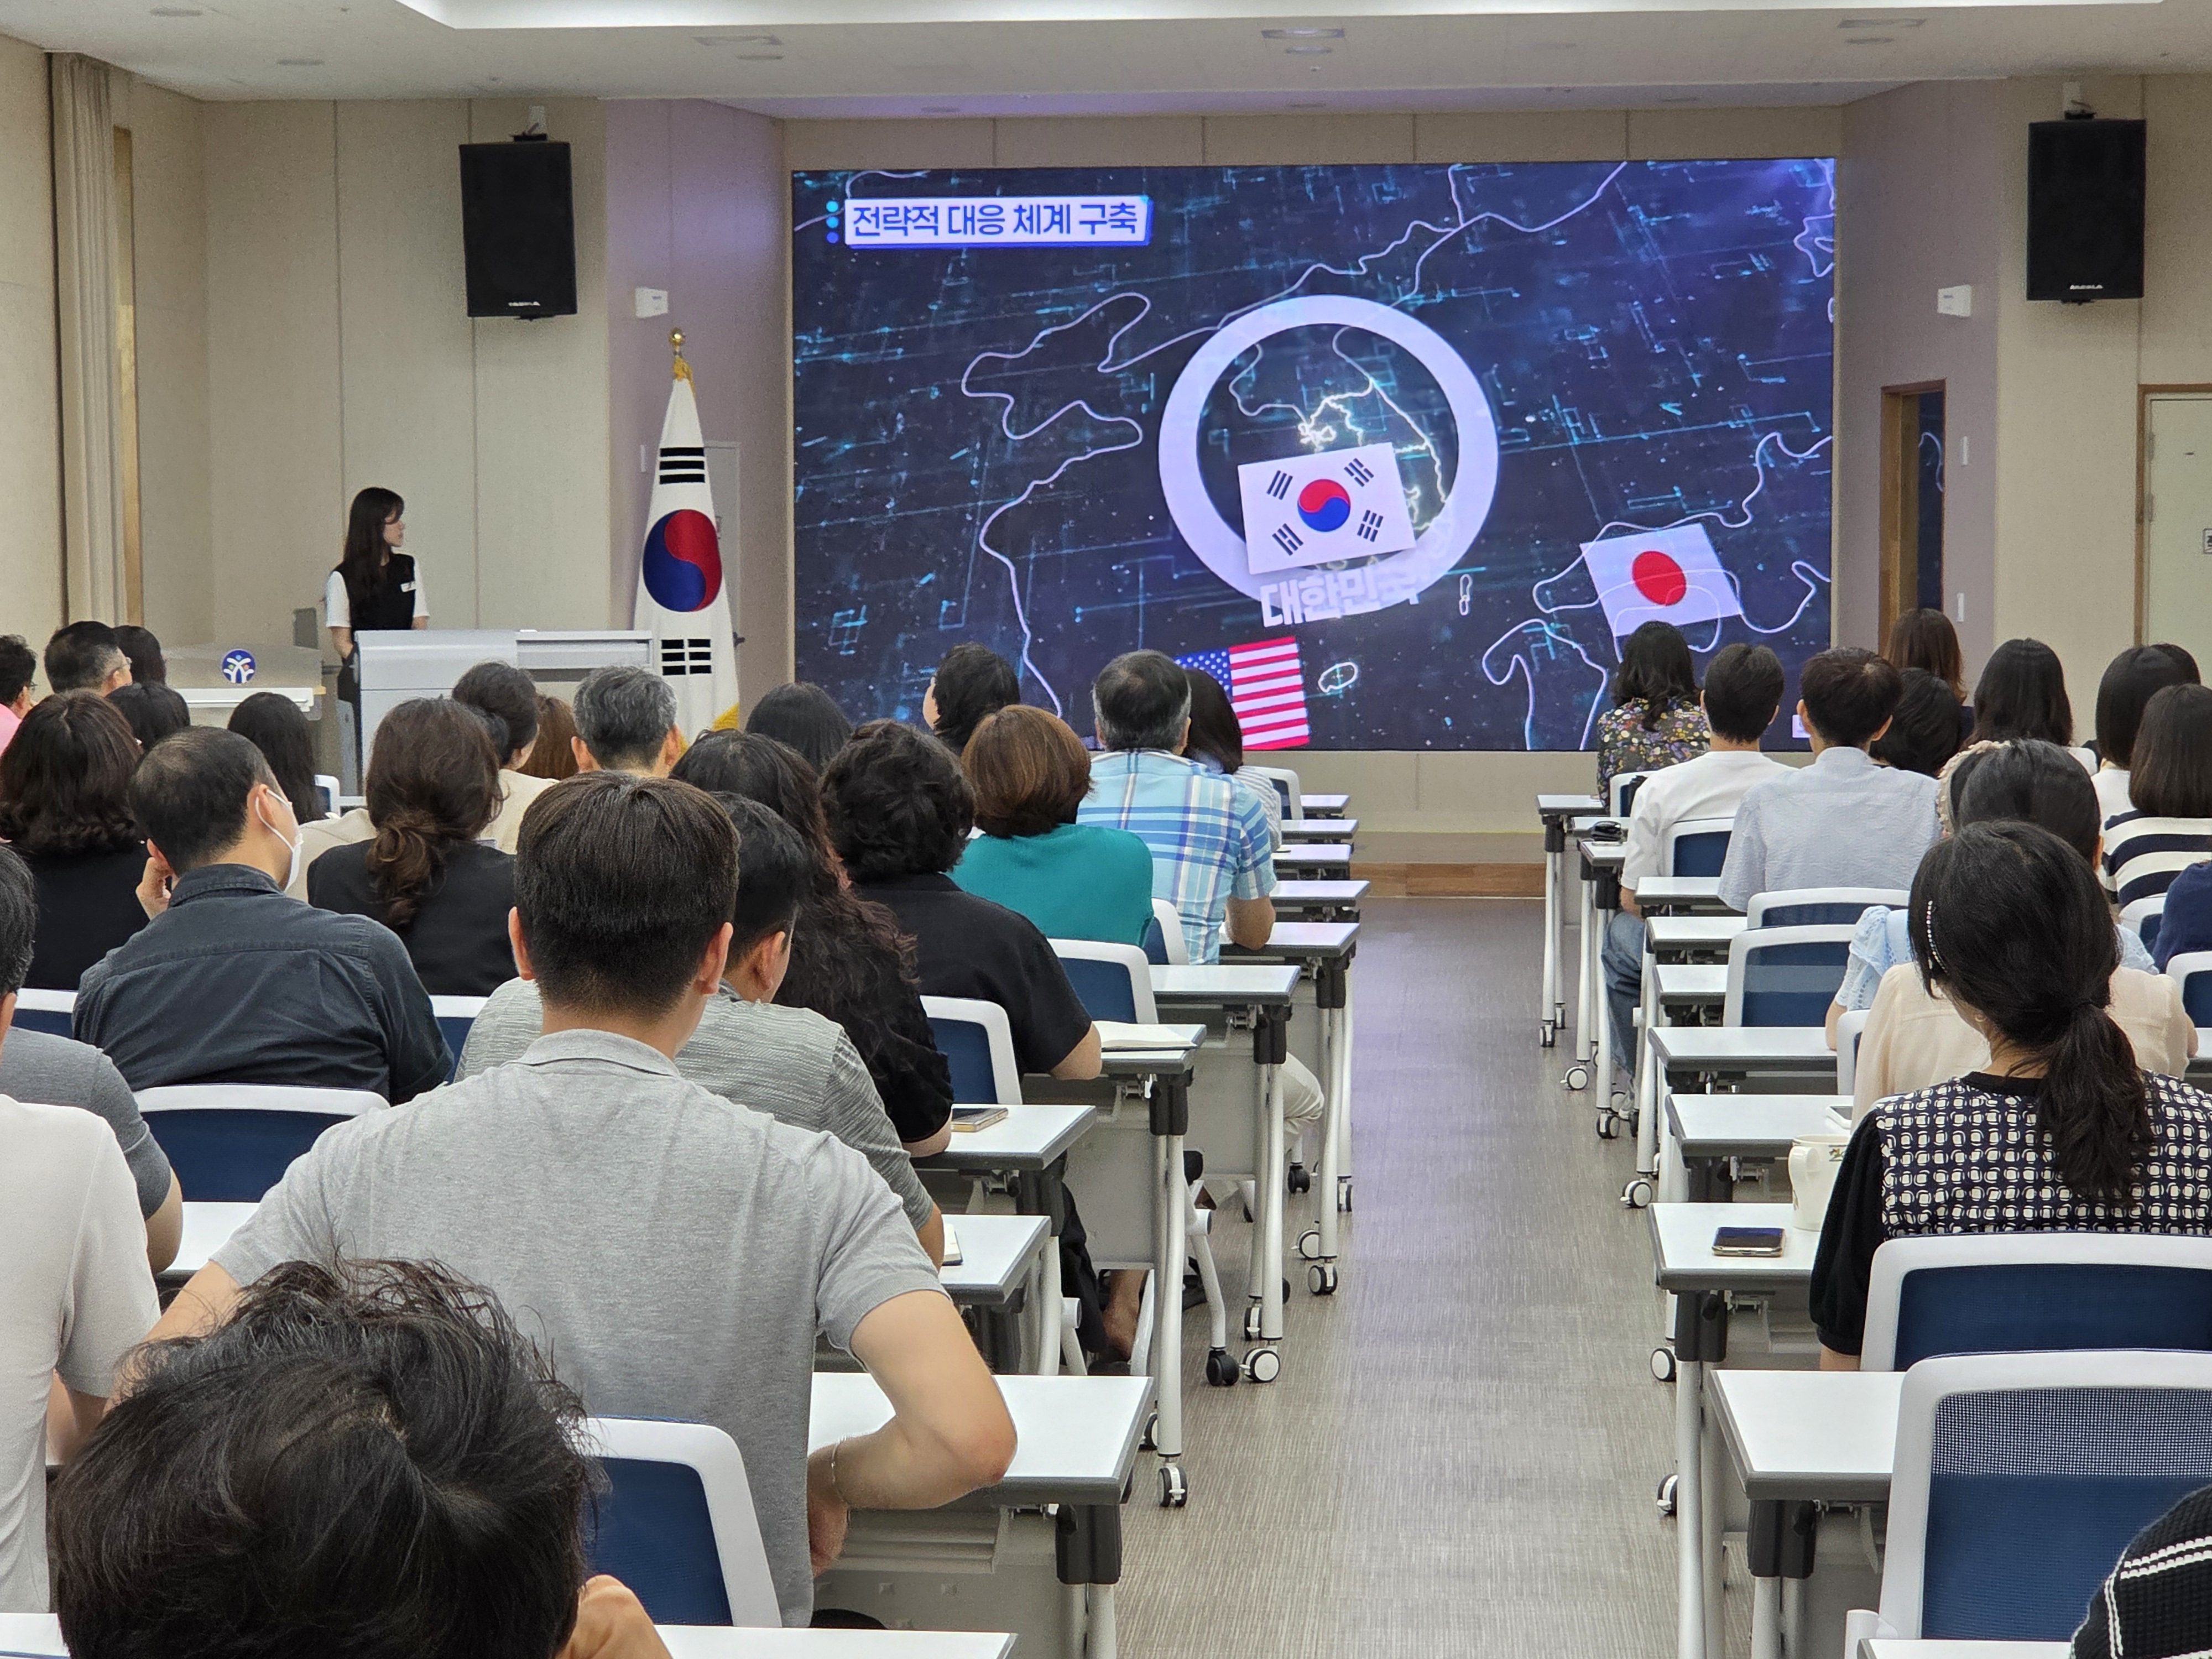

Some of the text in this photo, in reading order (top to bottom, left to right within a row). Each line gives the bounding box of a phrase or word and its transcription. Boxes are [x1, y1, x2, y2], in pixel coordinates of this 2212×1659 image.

[853, 202, 1138, 237] 전략적 대응 체계 구축
